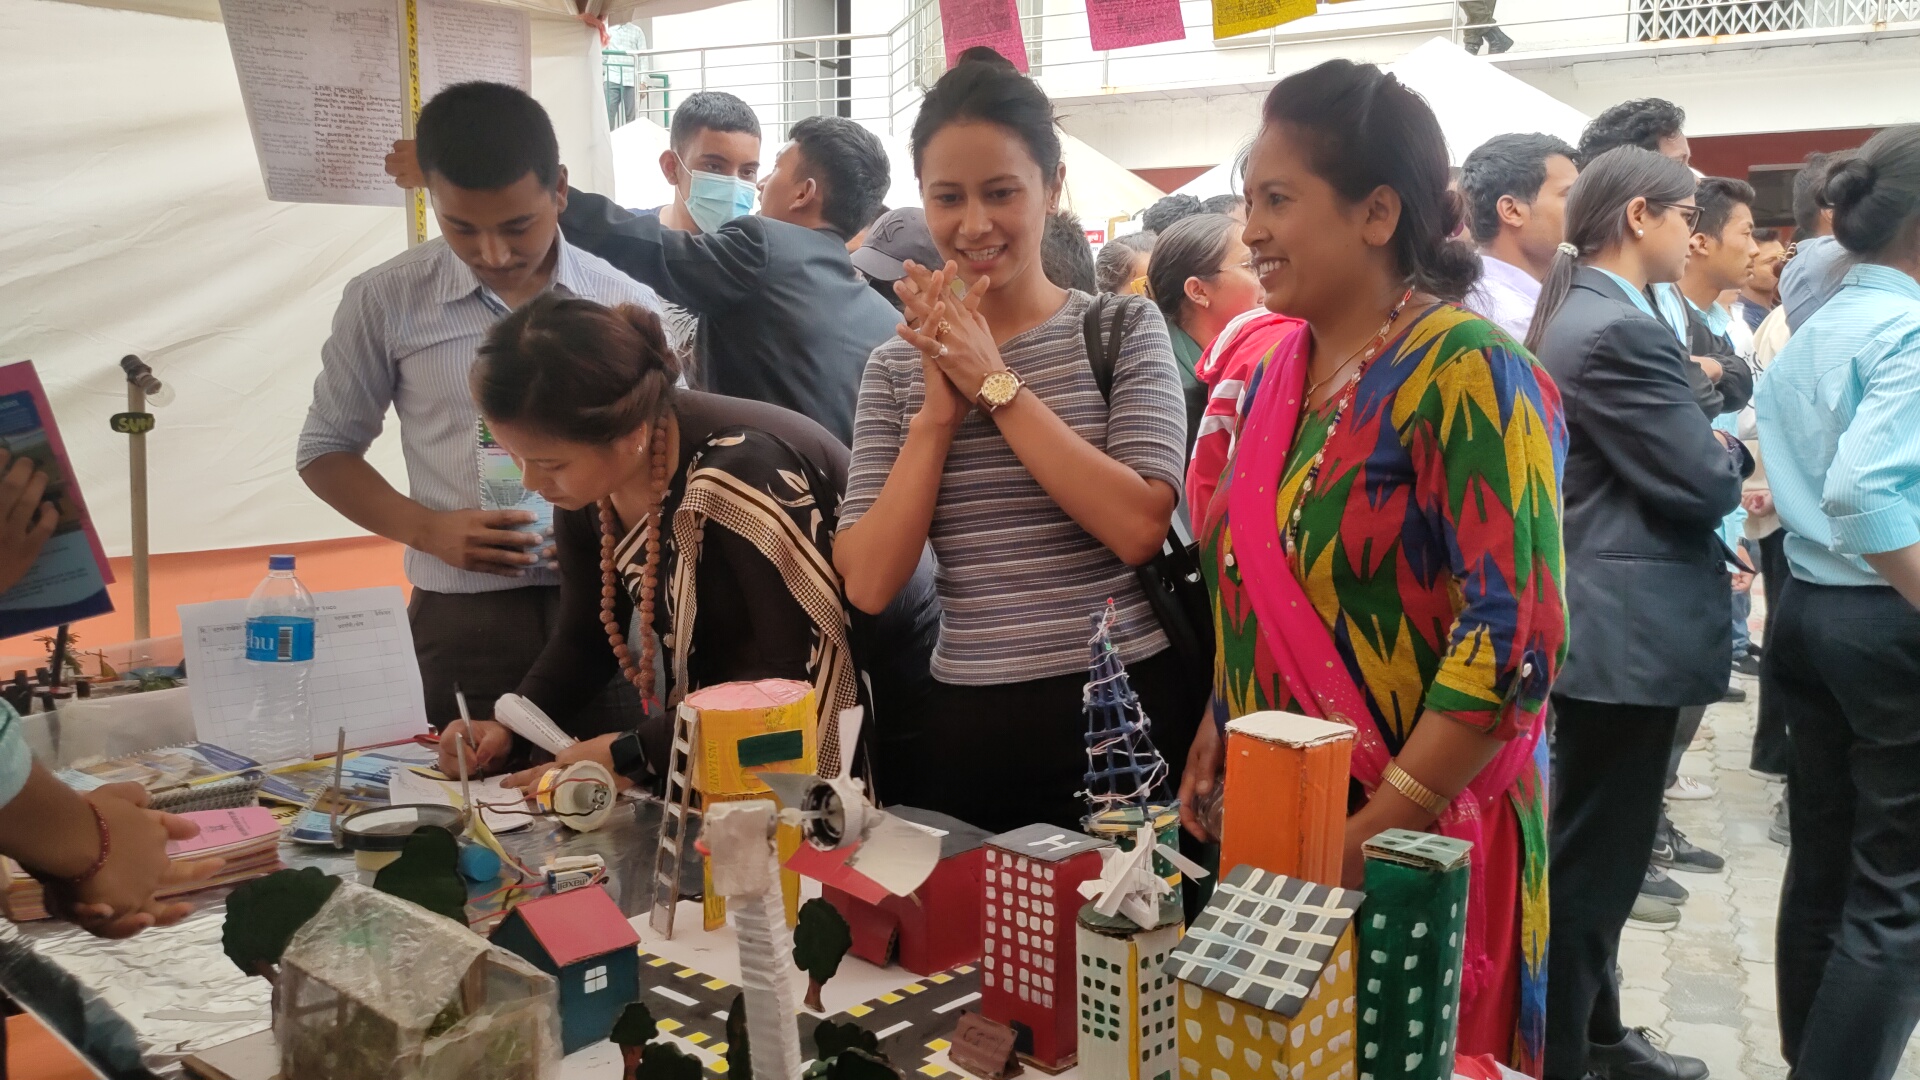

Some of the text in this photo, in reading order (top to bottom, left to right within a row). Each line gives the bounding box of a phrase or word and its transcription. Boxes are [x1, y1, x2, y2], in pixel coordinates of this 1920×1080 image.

[334, 87, 364, 95] MACHINE
[118, 417, 154, 432] SUN
[246, 628, 275, 651] hu
[1027, 834, 1083, 852] H
[557, 877, 588, 891] maxell
